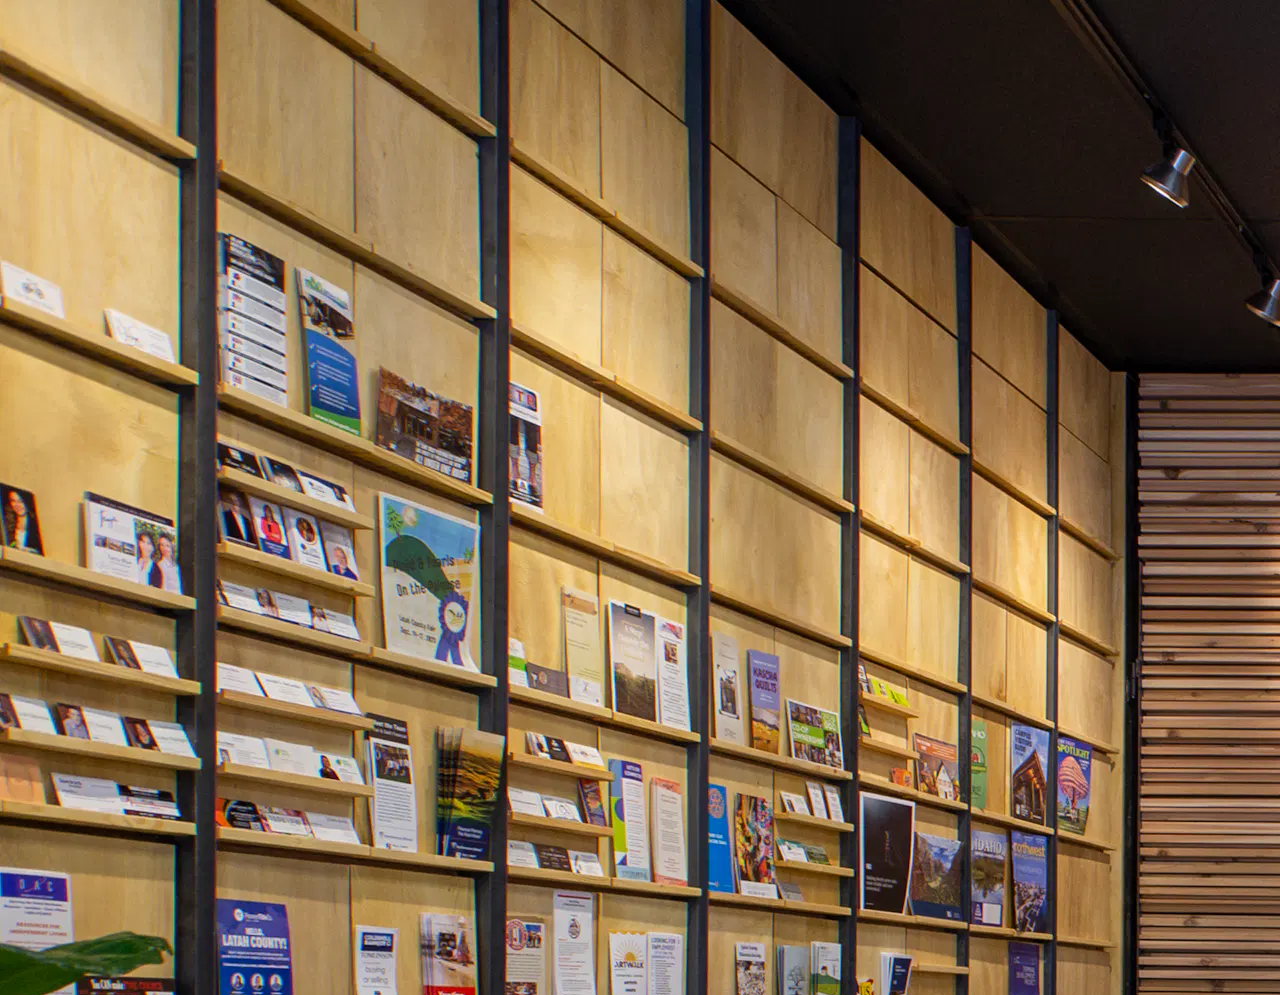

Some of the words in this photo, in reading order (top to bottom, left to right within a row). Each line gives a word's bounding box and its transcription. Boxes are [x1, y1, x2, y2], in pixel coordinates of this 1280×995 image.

[975, 837, 1002, 854] IDAHO
[222, 934, 249, 947] LATAH
[250, 936, 288, 950] COUNTY!
